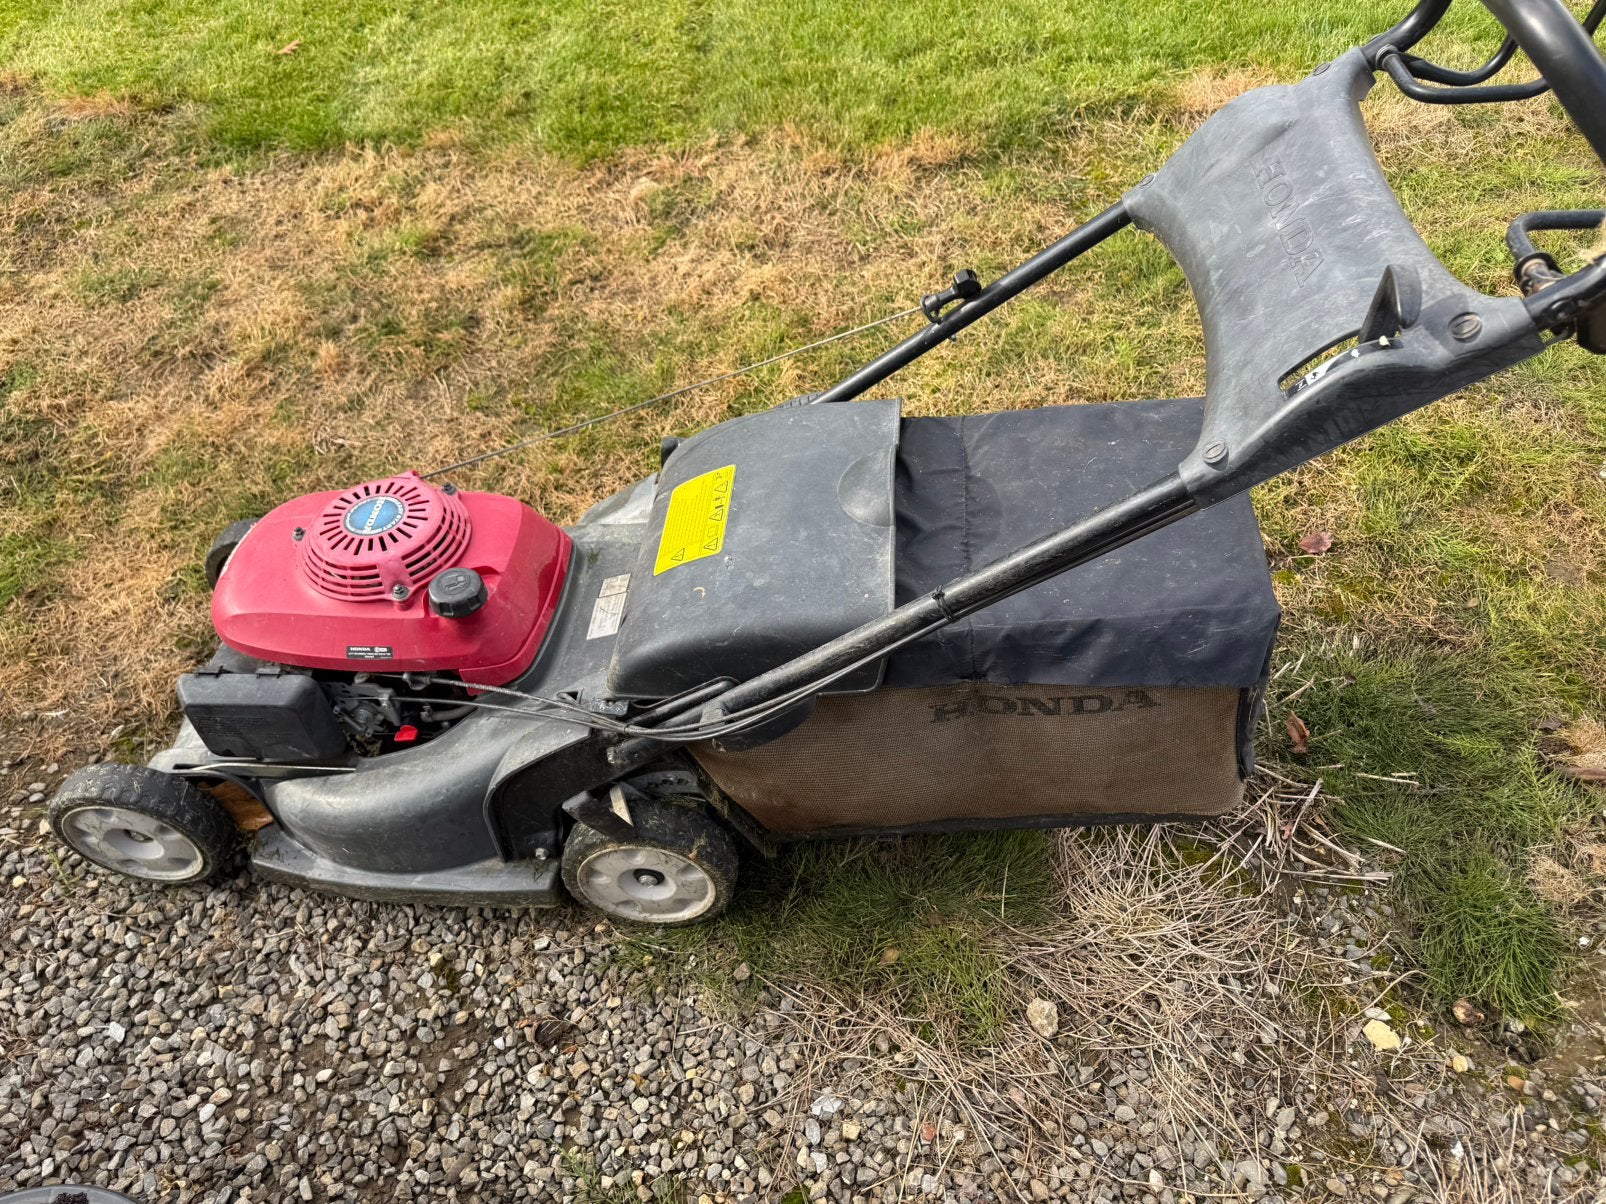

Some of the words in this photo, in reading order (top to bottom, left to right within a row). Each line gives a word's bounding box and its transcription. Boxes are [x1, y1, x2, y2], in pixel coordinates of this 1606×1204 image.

[1252, 154, 1325, 289] HONDA
[362, 496, 387, 534] HONDA
[928, 688, 1161, 723] HONDA
